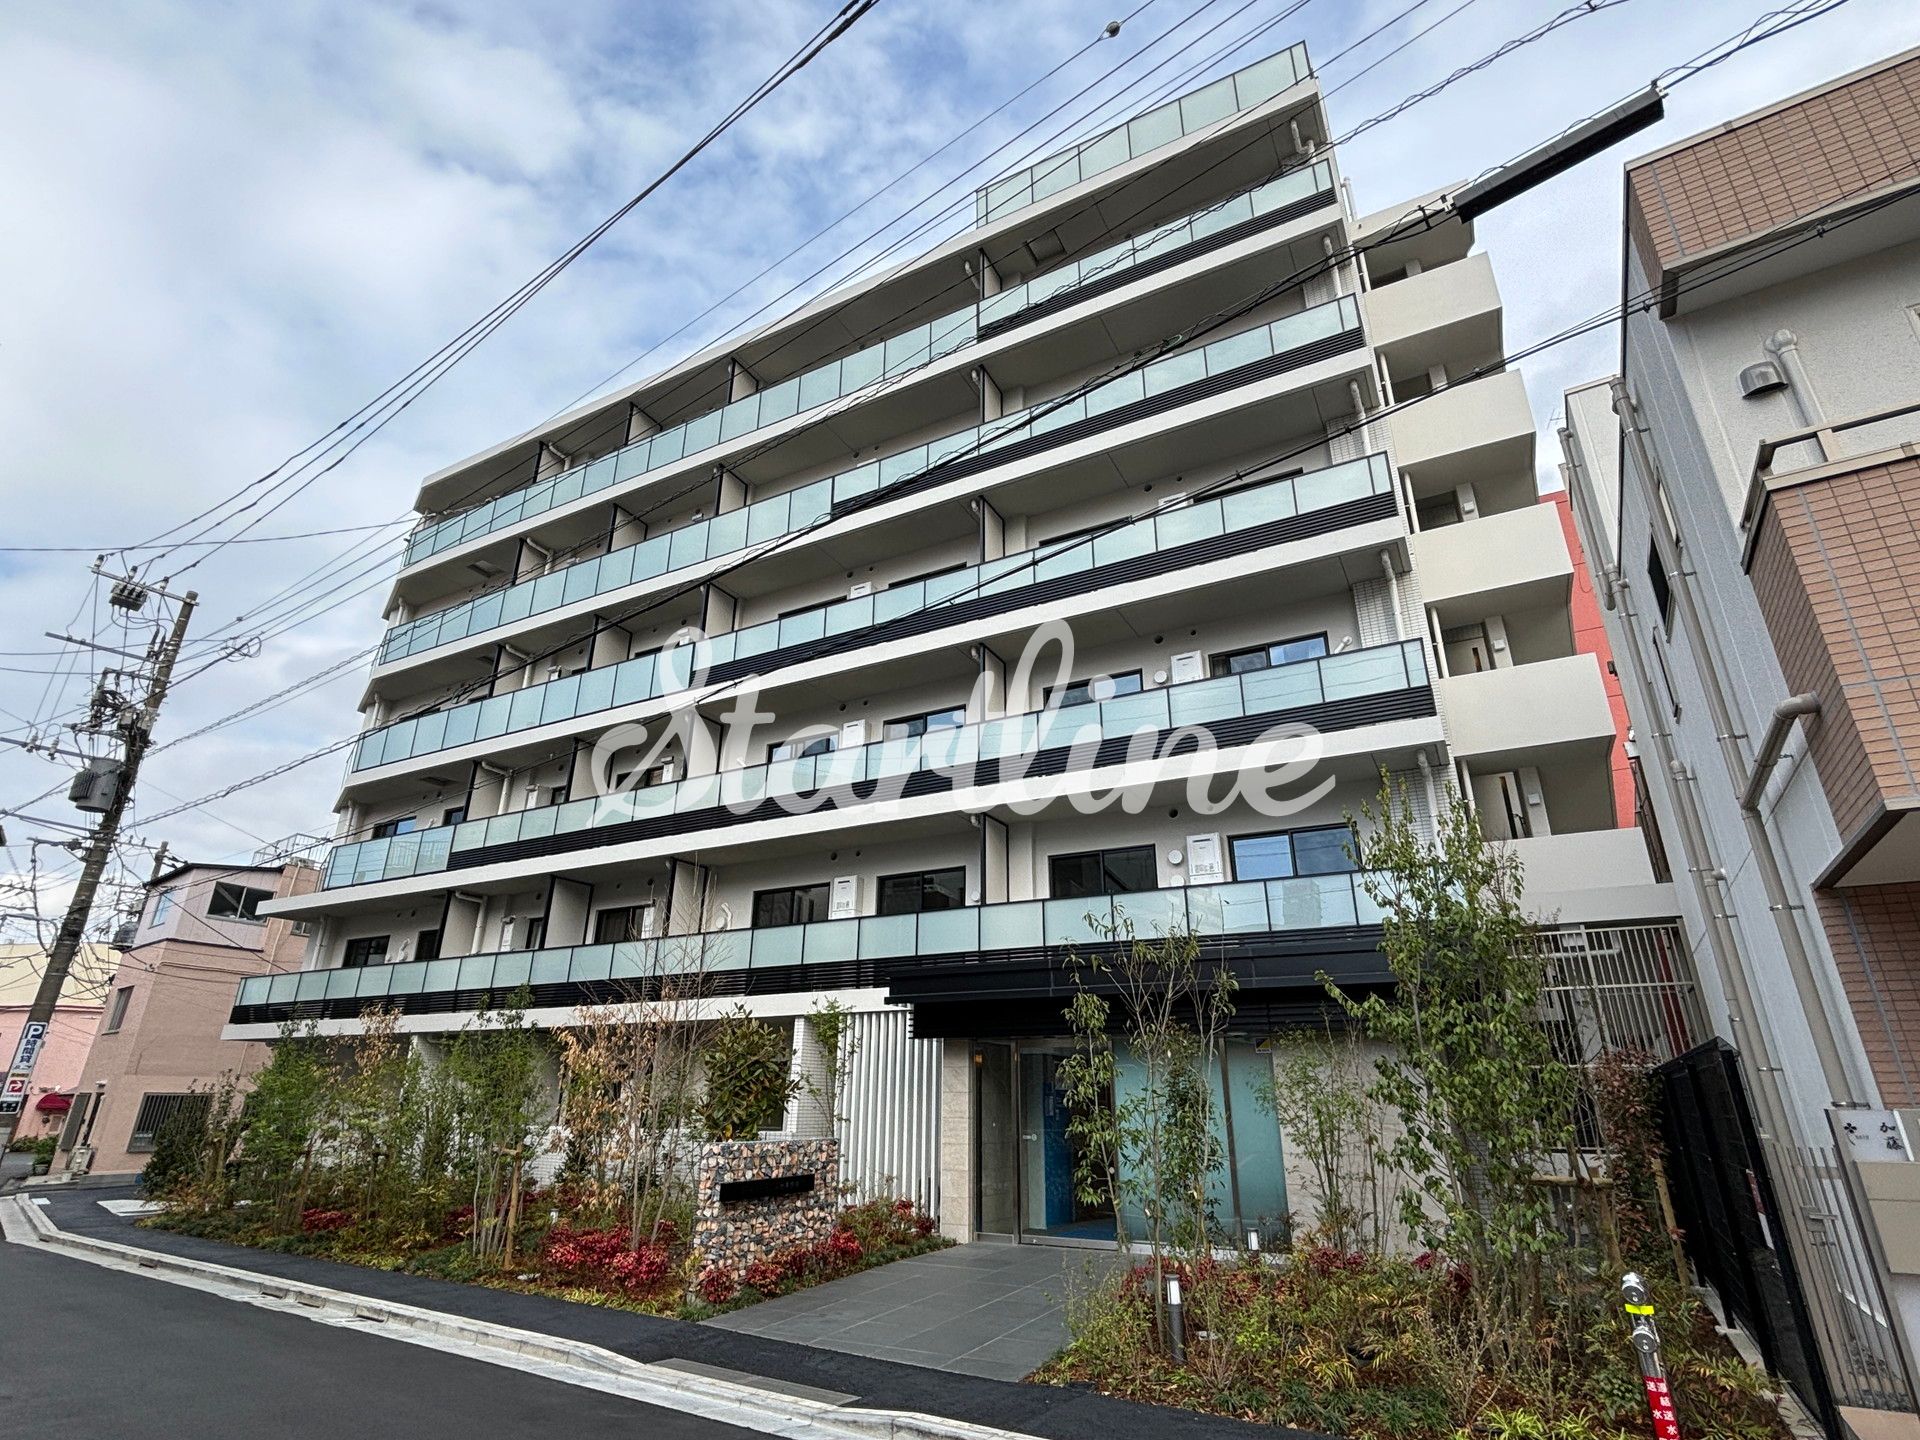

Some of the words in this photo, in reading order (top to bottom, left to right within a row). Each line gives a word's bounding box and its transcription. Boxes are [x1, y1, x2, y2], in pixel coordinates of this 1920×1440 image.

[20, 1039, 37, 1063] 時間貸
[28, 1025, 43, 1040] P
[1646, 1381, 1668, 1440] 送水
[1657, 1382, 1680, 1440] 連結送水
